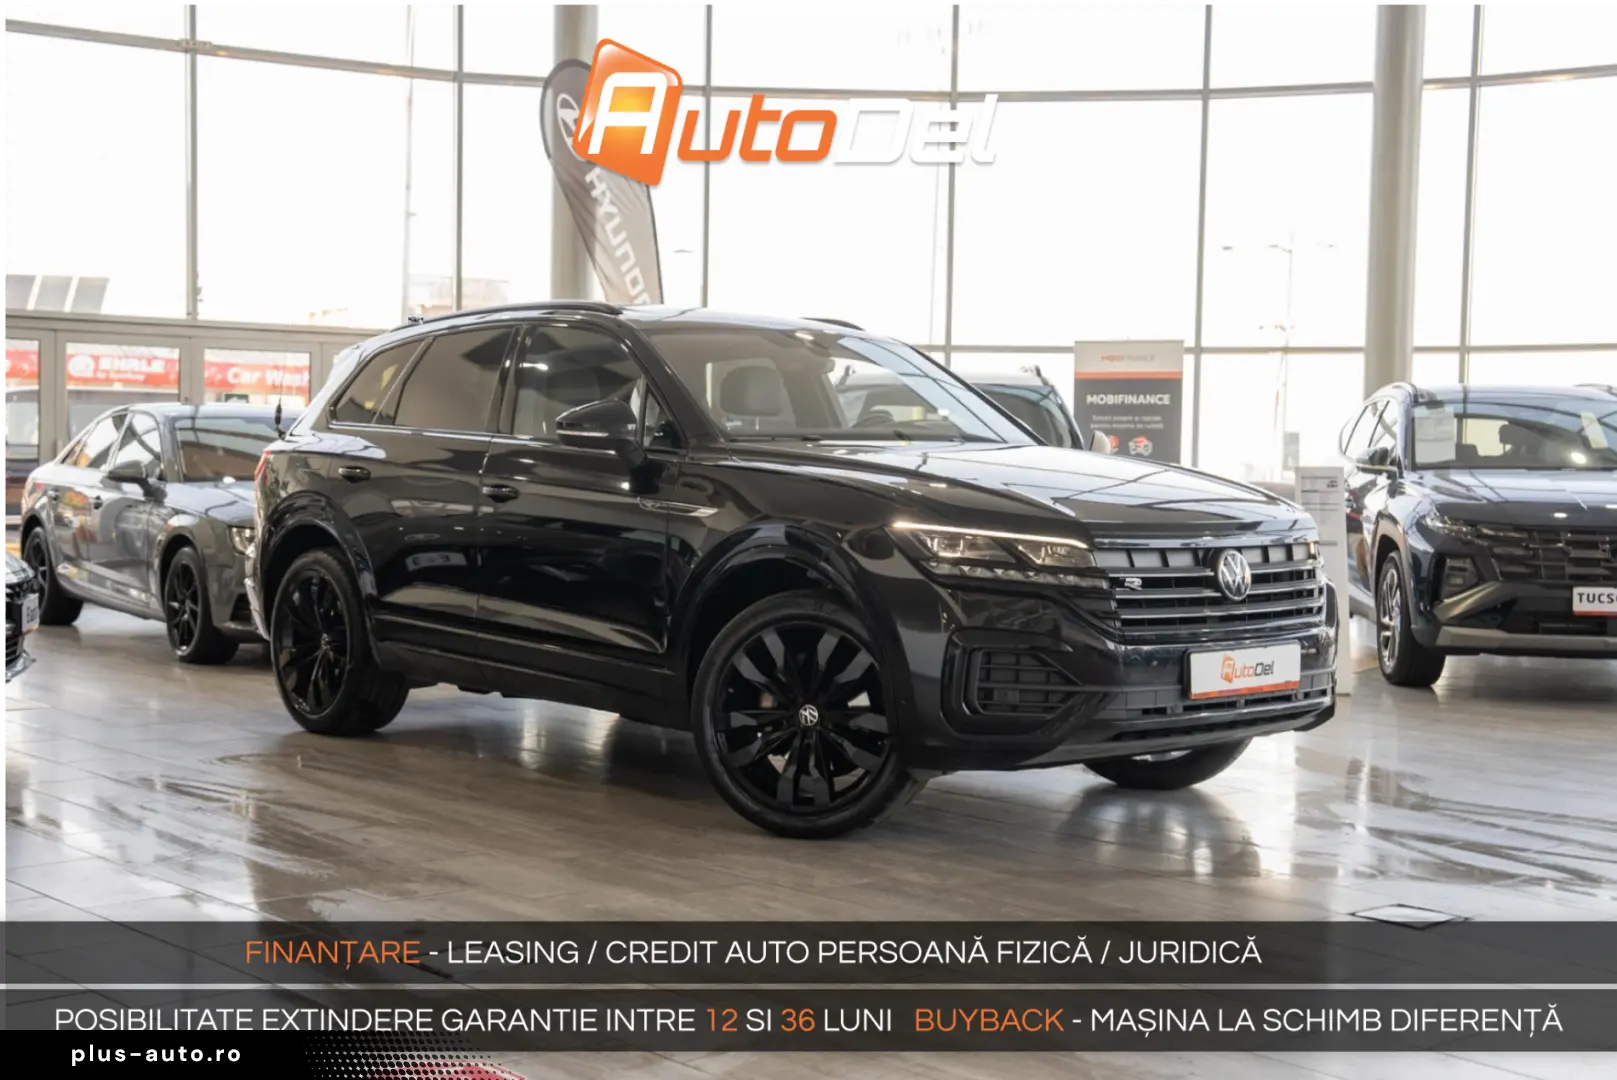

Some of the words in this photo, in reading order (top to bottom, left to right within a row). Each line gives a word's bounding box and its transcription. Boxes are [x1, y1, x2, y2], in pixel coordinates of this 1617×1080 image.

[227, 367, 261, 385] Car
[1086, 394, 1171, 405] MOBIFINANCE
[1577, 592, 1617, 604] TUCS
[1222, 659, 1275, 680] AutoDel
